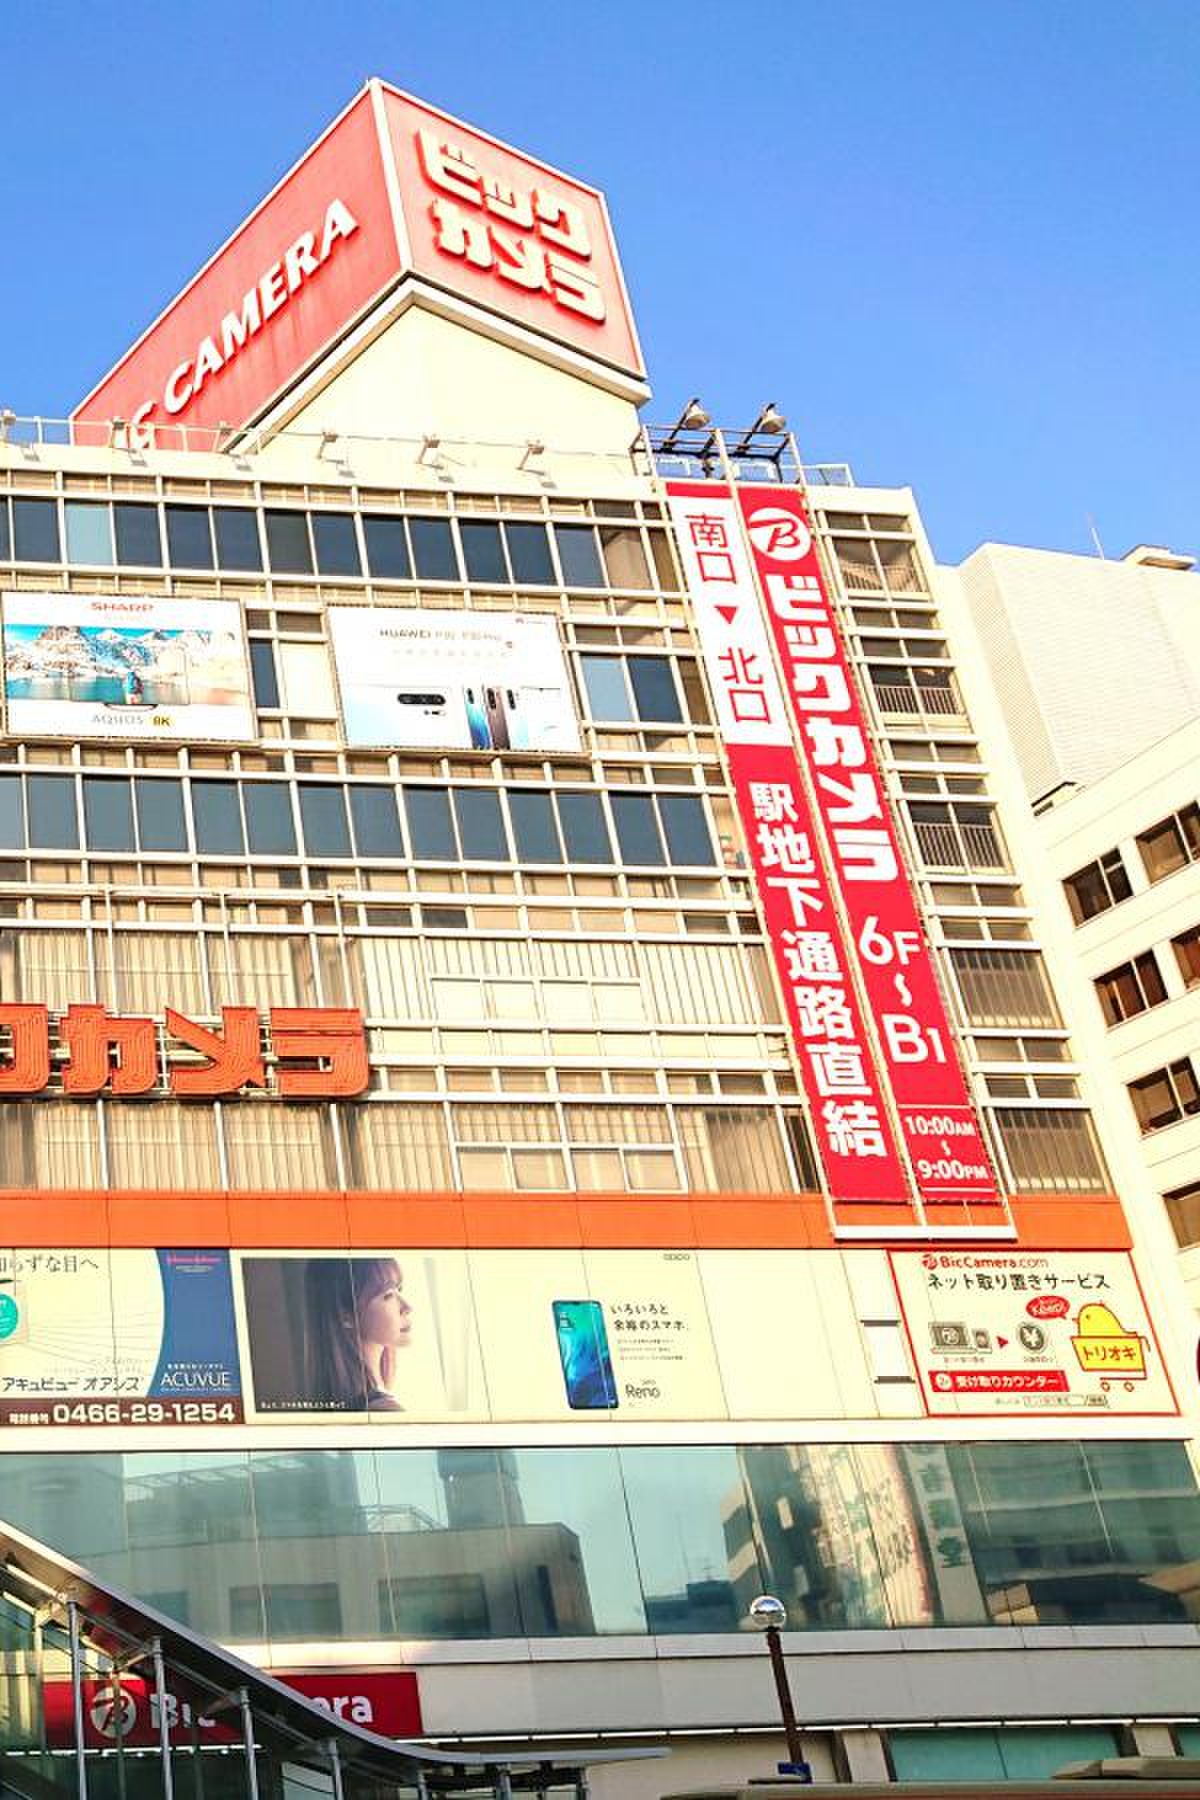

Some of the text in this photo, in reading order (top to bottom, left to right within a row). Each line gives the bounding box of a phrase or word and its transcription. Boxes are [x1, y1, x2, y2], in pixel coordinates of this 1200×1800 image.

[416, 127, 593, 261] ビック
[430, 199, 609, 325] カメラ
[163, 196, 360, 415] CAMERA
[685, 514, 772, 724] 南口 北口
[765, 575, 899, 882] ビックカメラ
[858, 916, 921, 967] 6F
[748, 782, 888, 1157] 駅地下通路直結
[881, 1013, 947, 1064] B1
[905, 1115, 977, 1138] 10:00AM
[917, 1159, 989, 1181] 9:00PM
[928, 1273, 1111, 1291] ネット取り置きサービス
[1083, 1345, 1137, 1362] トリオキ
[160, 1371, 233, 1388] ACUVUE
[53, 1403, 236, 1423] 0466-29-1254
